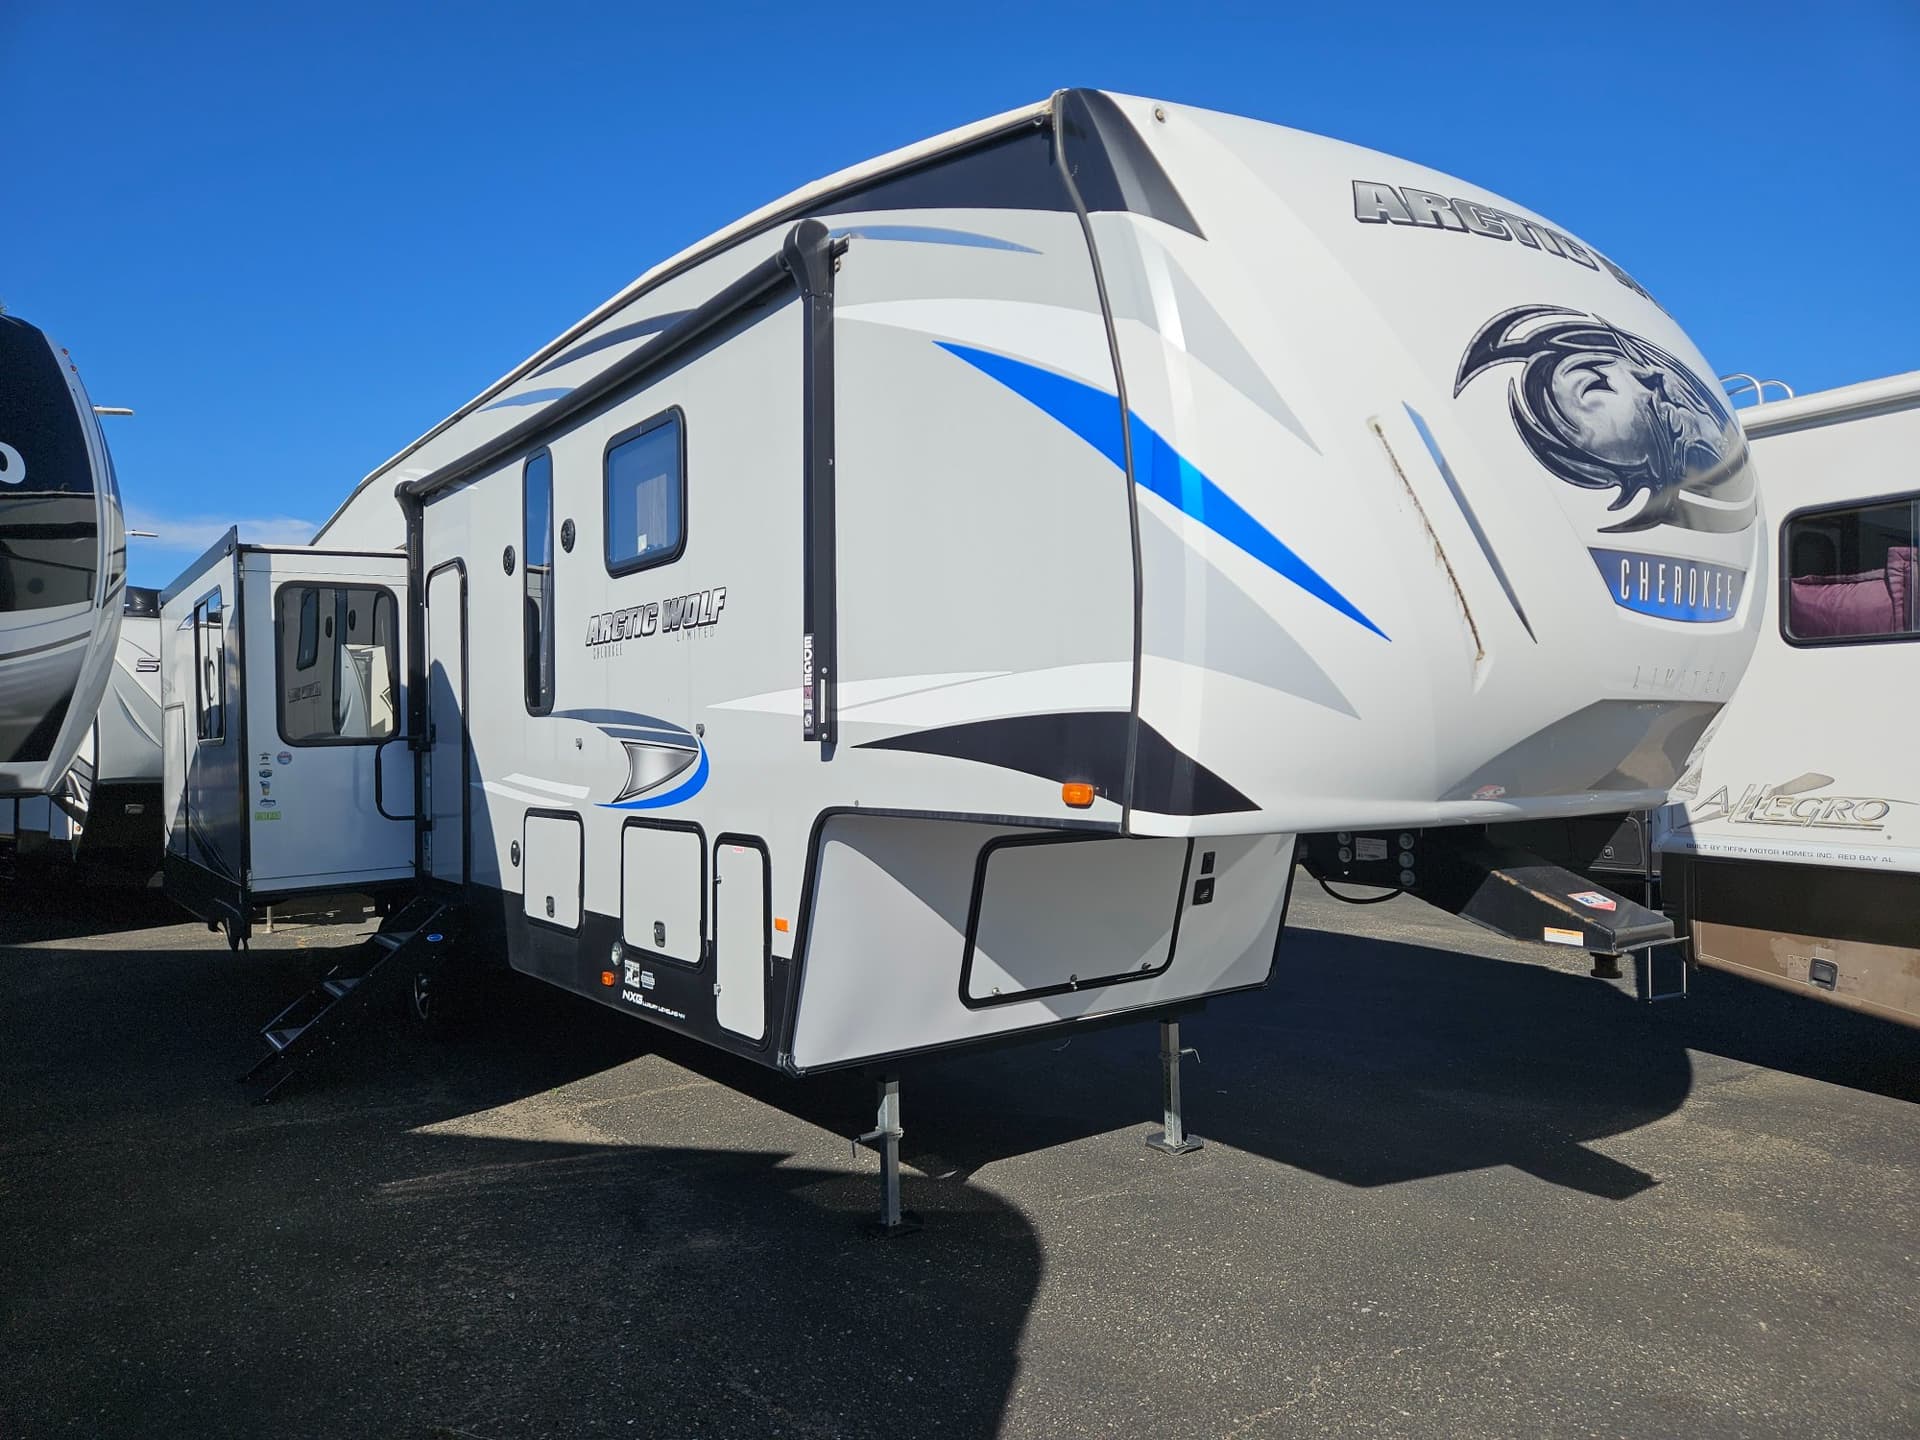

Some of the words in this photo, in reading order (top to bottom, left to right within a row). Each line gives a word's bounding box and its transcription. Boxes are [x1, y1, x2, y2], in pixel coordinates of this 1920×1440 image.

[1352, 180, 1600, 272] ARCTIC
[1620, 558, 1733, 612] CHEROKEE
[585, 602, 660, 647] ARCTIC
[661, 587, 727, 633] WOLF
[804, 635, 813, 686] EDGE
[1749, 847, 1780, 855] MOTOR
[1782, 849, 1813, 857] HOMES
[1859, 854, 1879, 862] BAY
[622, 988, 643, 1005] NXG
